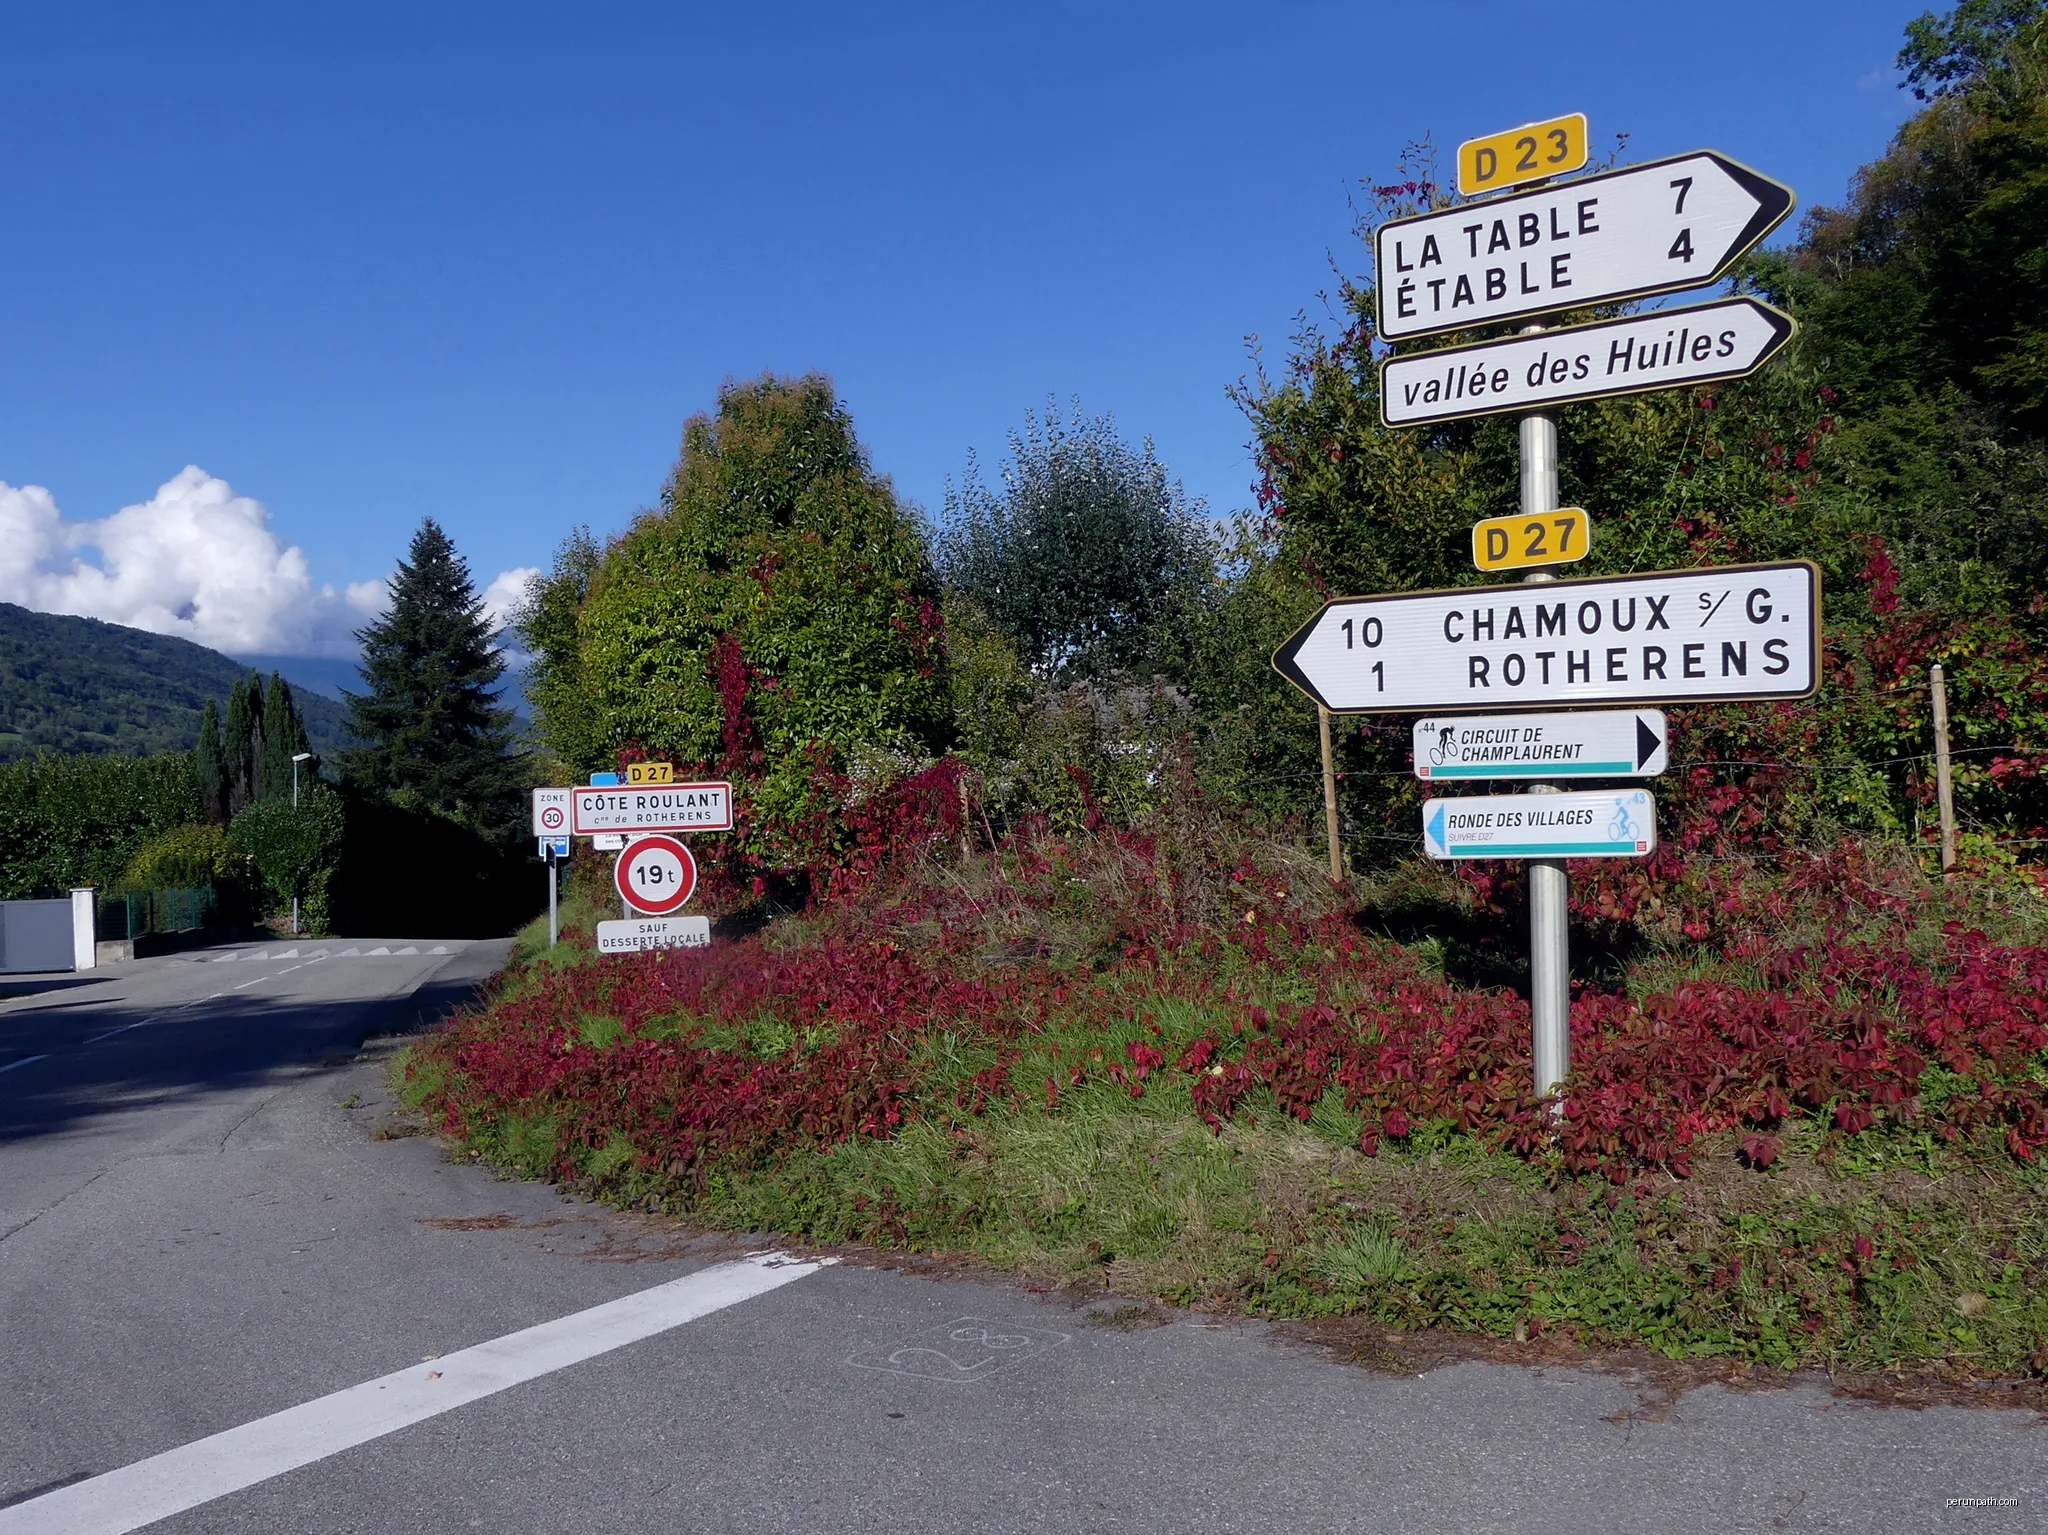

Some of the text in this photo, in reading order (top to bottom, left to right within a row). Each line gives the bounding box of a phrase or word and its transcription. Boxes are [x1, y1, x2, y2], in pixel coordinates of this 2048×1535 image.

[1475, 128, 1568, 182] D 23
[1670, 177, 1693, 215] 7
[1396, 198, 1600, 273] LA TABLE
[1668, 228, 1695, 264] 4
[1397, 252, 1572, 319] ÉTABLE
[1404, 328, 1736, 407] vallée des Huiles
[1487, 517, 1577, 562] D 27
[1443, 595, 1671, 643] CHAMOUX
[1745, 587, 1790, 625] G.
[1340, 617, 1384, 650] 10
[1371, 660, 1384, 692] 1
[1468, 638, 1790, 688] ROTHERENS
[1461, 727, 1543, 745] CIRCUIT DE
[1461, 744, 1584, 762] CHAMPLAURENT
[632, 767, 669, 781] D 27
[583, 793, 720, 811] CÔTE ROULANT
[546, 813, 560, 823] 30
[615, 815, 627, 823] de
[637, 811, 711, 822] ROTHERENS
[1448, 809, 1593, 829] RONDE DES VILLAGES
[1448, 832, 1494, 841] SUIVRE D27
[636, 865, 675, 885] 19 t
[639, 924, 668, 933] SAUF
[603, 936, 660, 948] DESSERTE
